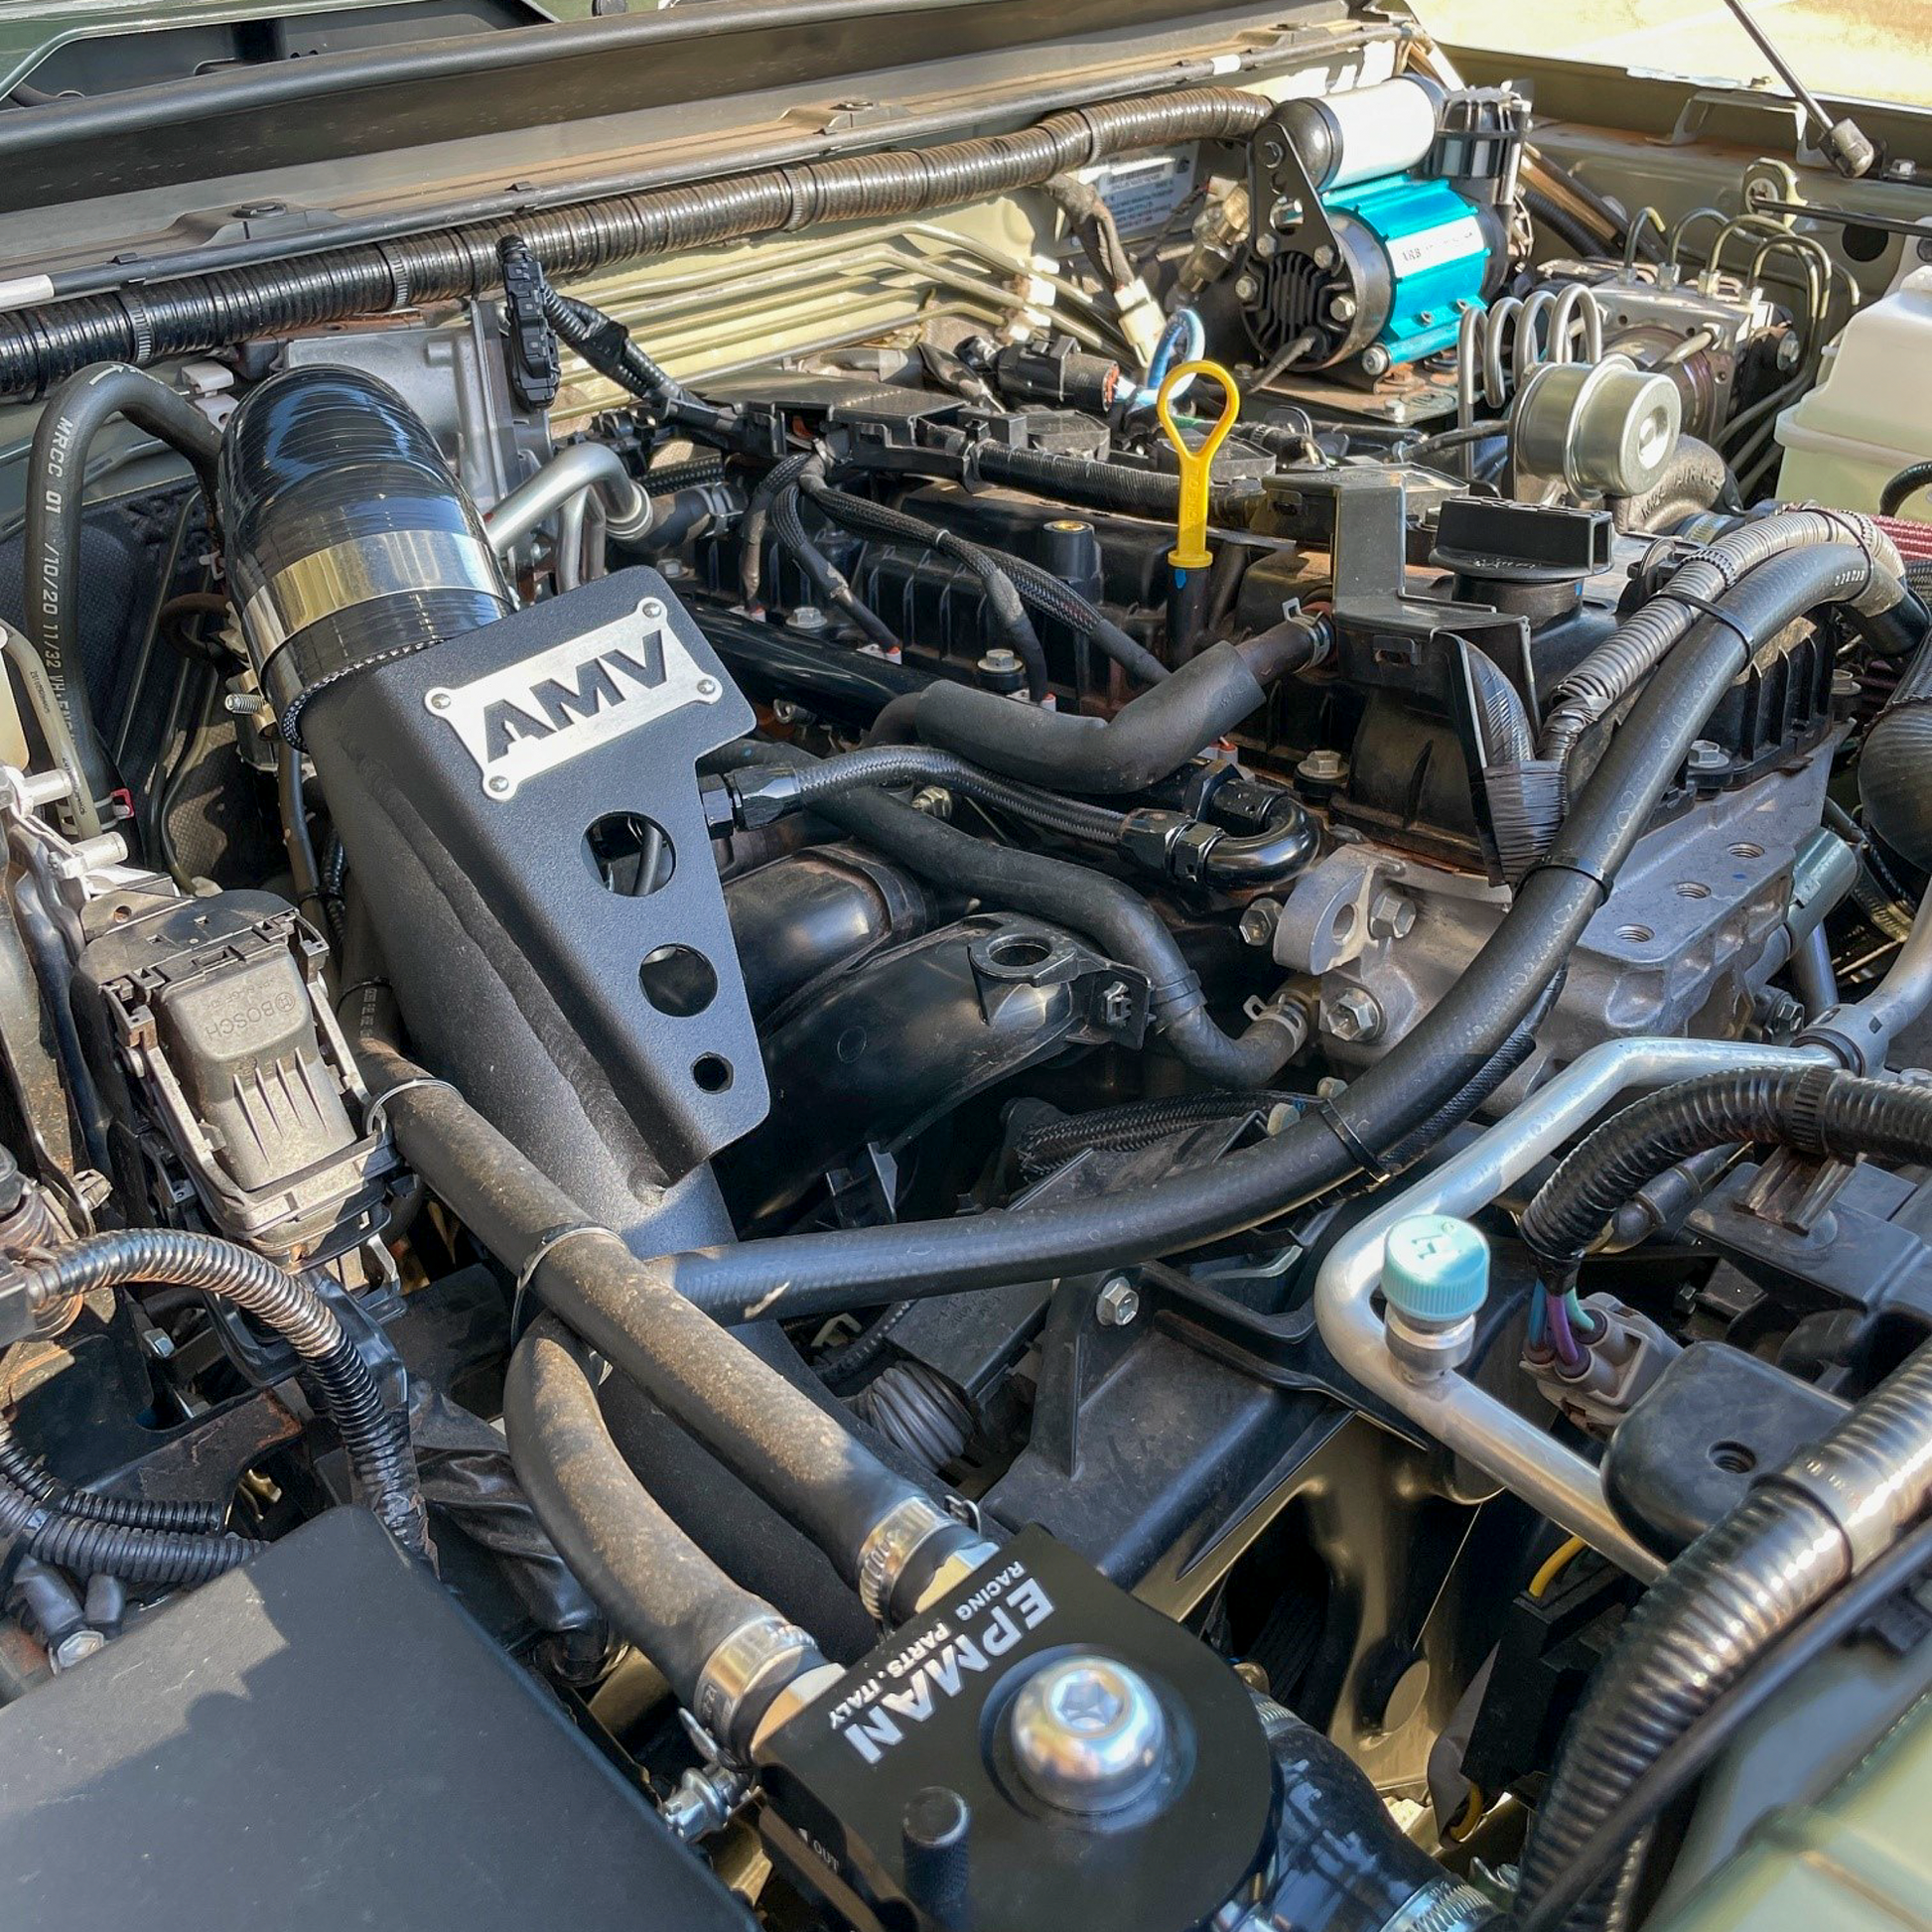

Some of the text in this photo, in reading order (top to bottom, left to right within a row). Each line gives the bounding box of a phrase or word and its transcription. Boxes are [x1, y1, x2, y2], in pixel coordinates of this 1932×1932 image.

[48, 416, 73, 478] MRCC
[45, 489, 63, 514] 01
[43, 623, 62, 669] 11/32
[483, 628, 667, 763] AMV
[205, 1000, 275, 1041] BOSCH
[955, 1560, 1027, 1621] RACING
[845, 1577, 1055, 1765] EPMAN
[813, 1839, 839, 1873] OUT
